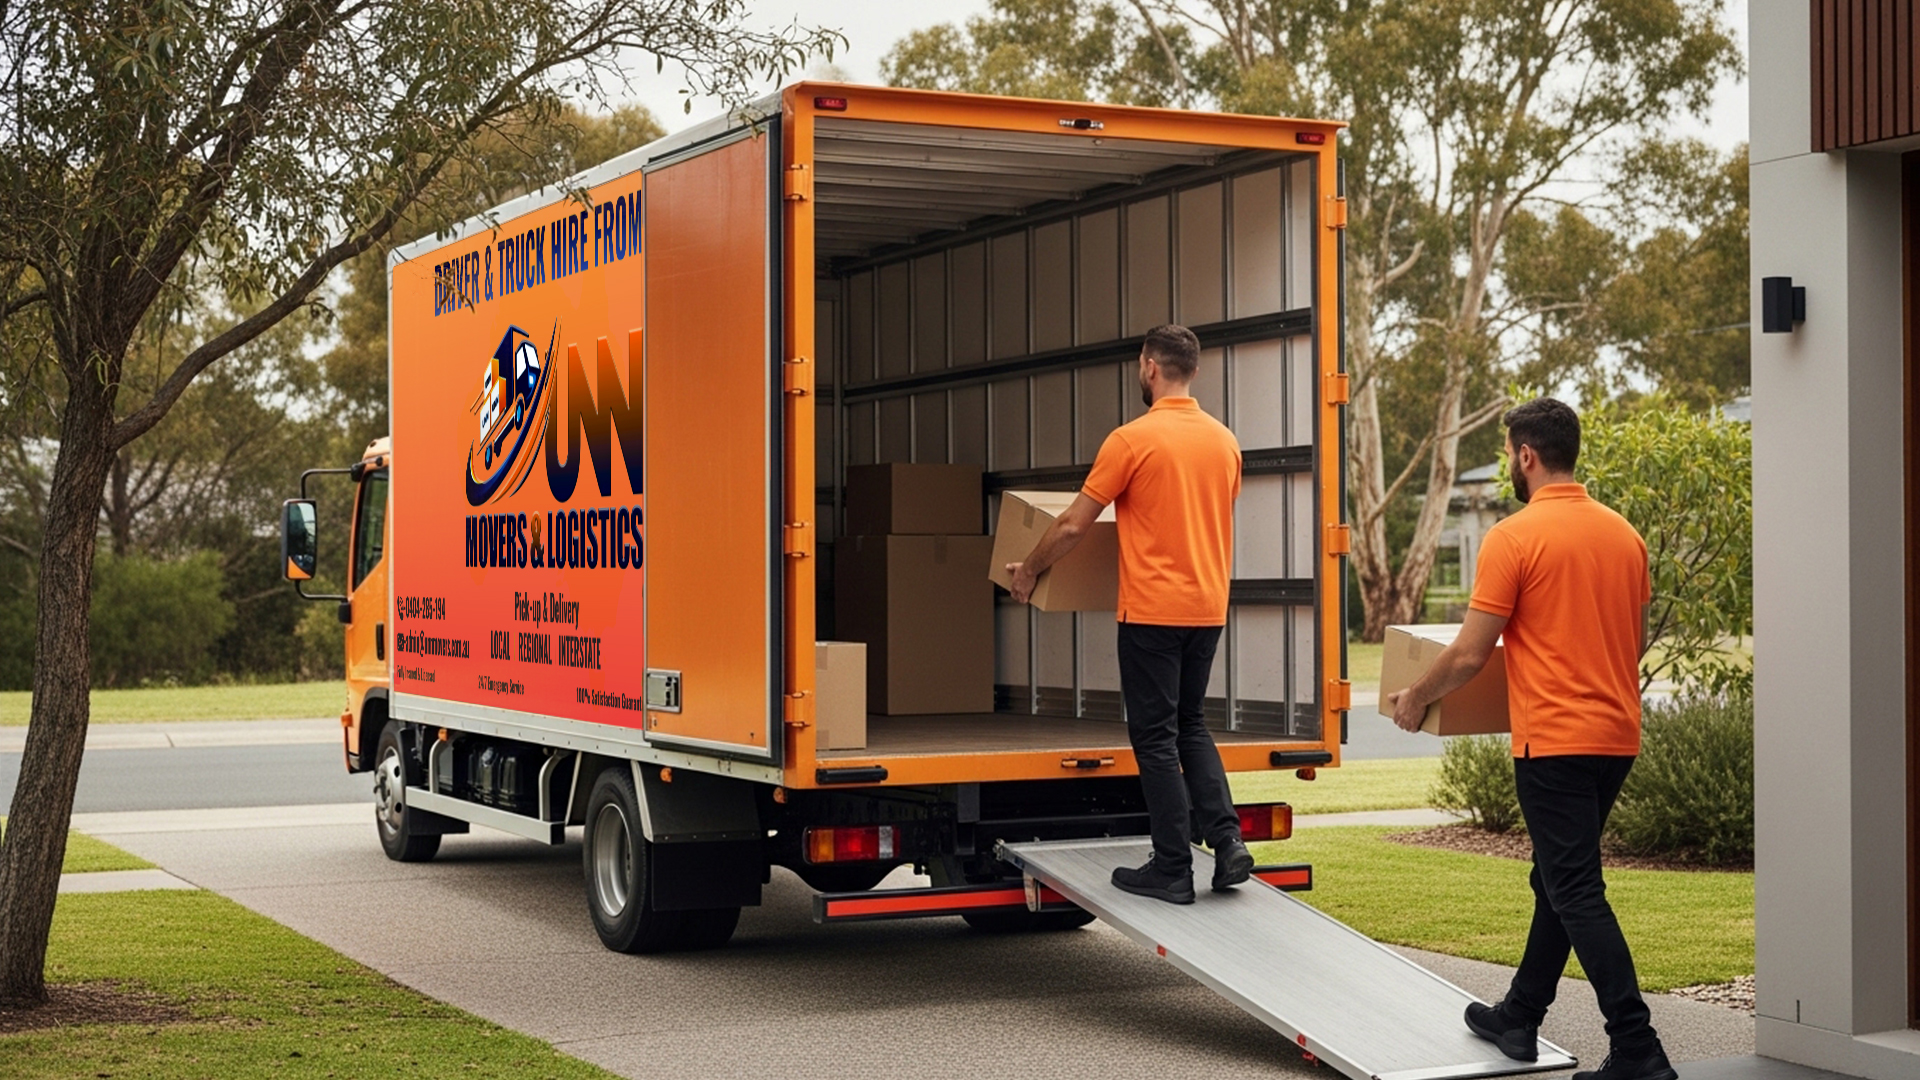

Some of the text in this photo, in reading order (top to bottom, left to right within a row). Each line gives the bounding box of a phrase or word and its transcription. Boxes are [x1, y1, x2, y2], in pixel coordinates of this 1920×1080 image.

[435, 190, 642, 317] DRIVER & TRUCK HIRE FROM
[465, 504, 643, 569] MOVERS & LOGISTICS
[514, 591, 579, 630] Pick-up & Delivery
[490, 630, 601, 669] LOCAL REGIONAL INTERSTATE
[591, 689, 621, 708] Satisfaction
